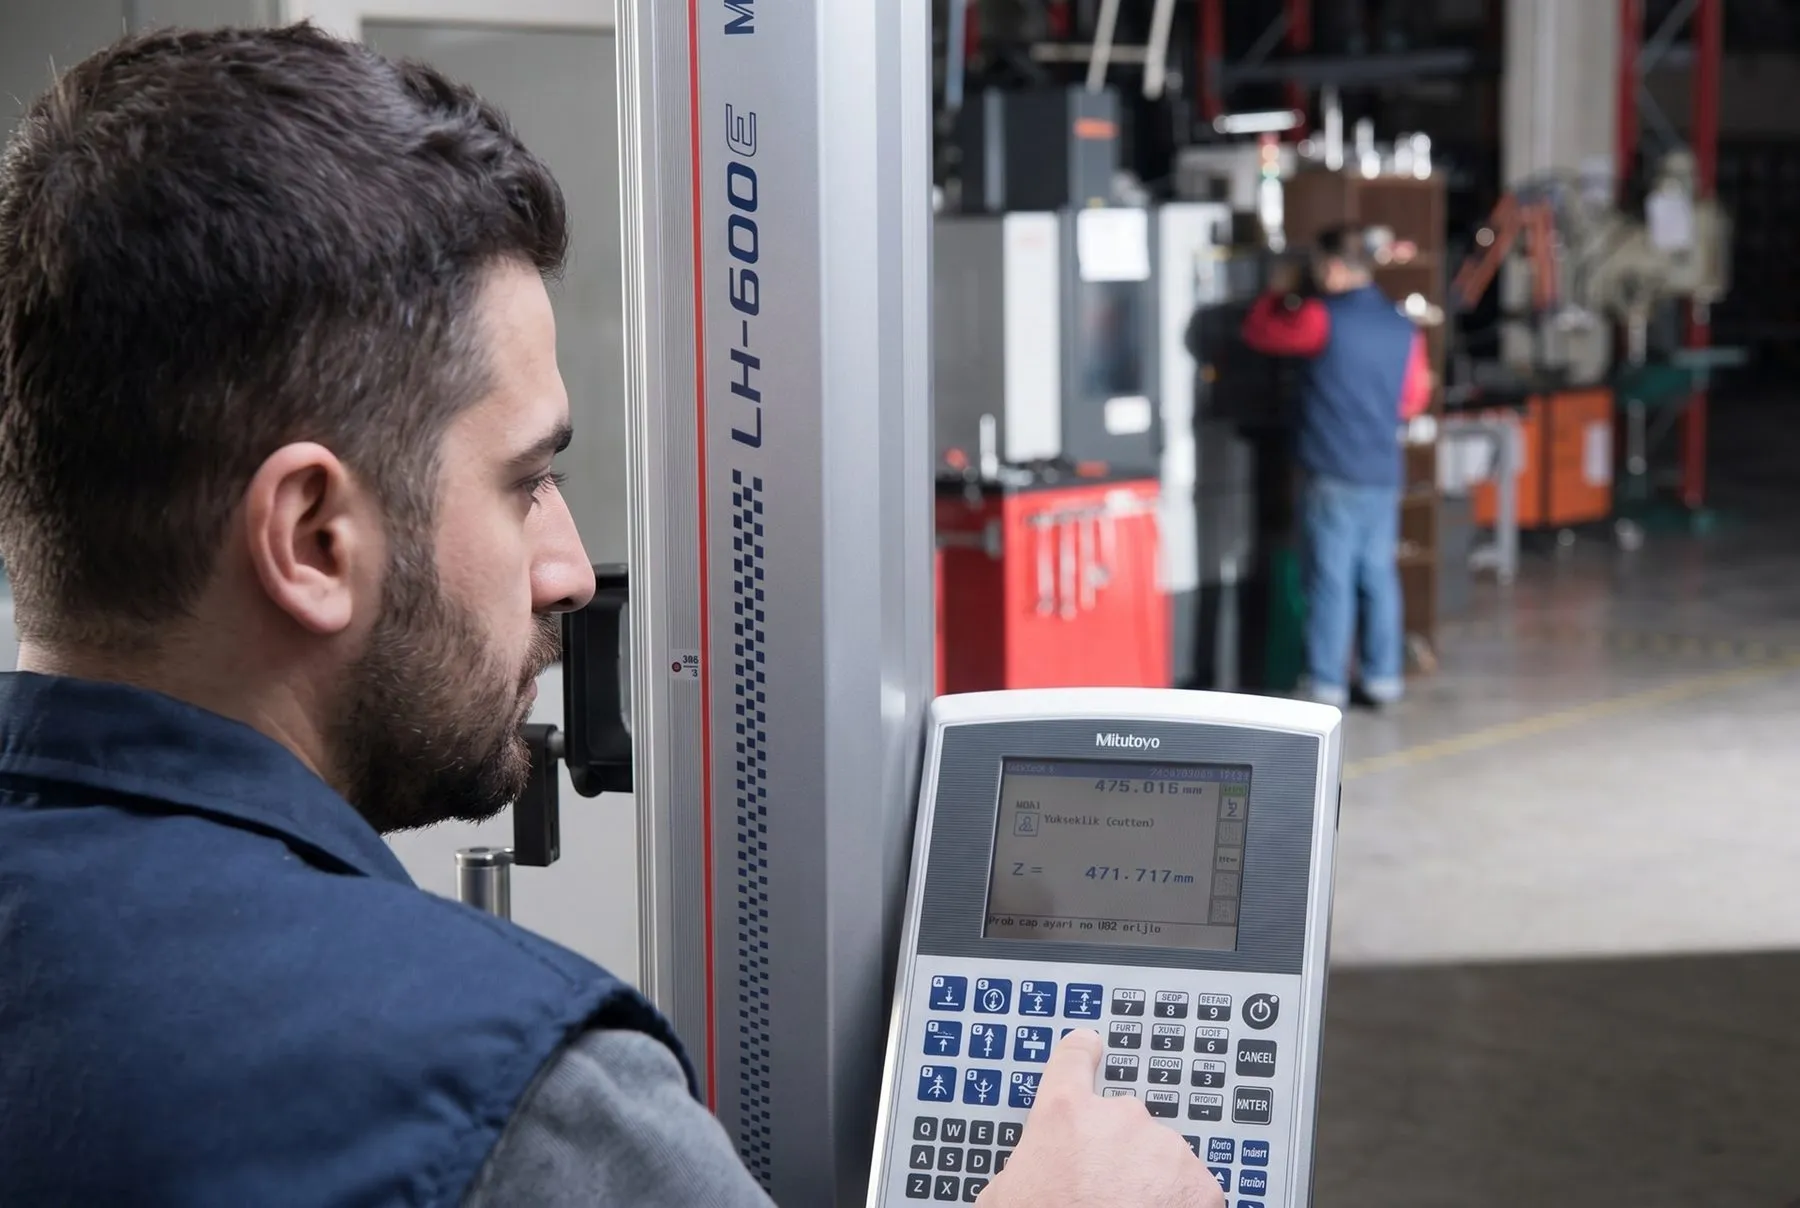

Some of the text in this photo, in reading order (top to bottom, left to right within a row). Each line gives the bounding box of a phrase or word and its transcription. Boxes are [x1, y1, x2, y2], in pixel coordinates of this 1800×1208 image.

[726, 104, 763, 448] LH-600E
[1095, 732, 1160, 751] Mitutoyo
[1012, 862, 1025, 876] Z
[1085, 866, 1172, 883] 471.717
[1173, 874, 1194, 884] mm
[1124, 1002, 1132, 1014] 7
[1166, 1004, 1175, 1016] 8
[1210, 1007, 1218, 1019] 9
[1120, 1035, 1129, 1046] 4
[1163, 1038, 1172, 1049] 5
[1207, 1040, 1215, 1052] 6
[1118, 1068, 1124, 1079] 1
[1160, 1071, 1169, 1082] 2
[1204, 1074, 1212, 1085] 3
[919, 1122, 931, 1136] Q
[946, 1123, 961, 1137] W
[977, 1126, 987, 1139] E
[1005, 1128, 1015, 1141] R
[916, 1151, 928, 1164] A
[945, 1153, 955, 1166] S
[973, 1155, 984, 1168] D
[913, 1179, 924, 1192] Z
[941, 1181, 953, 1195] X
[970, 1184, 980, 1197] C
